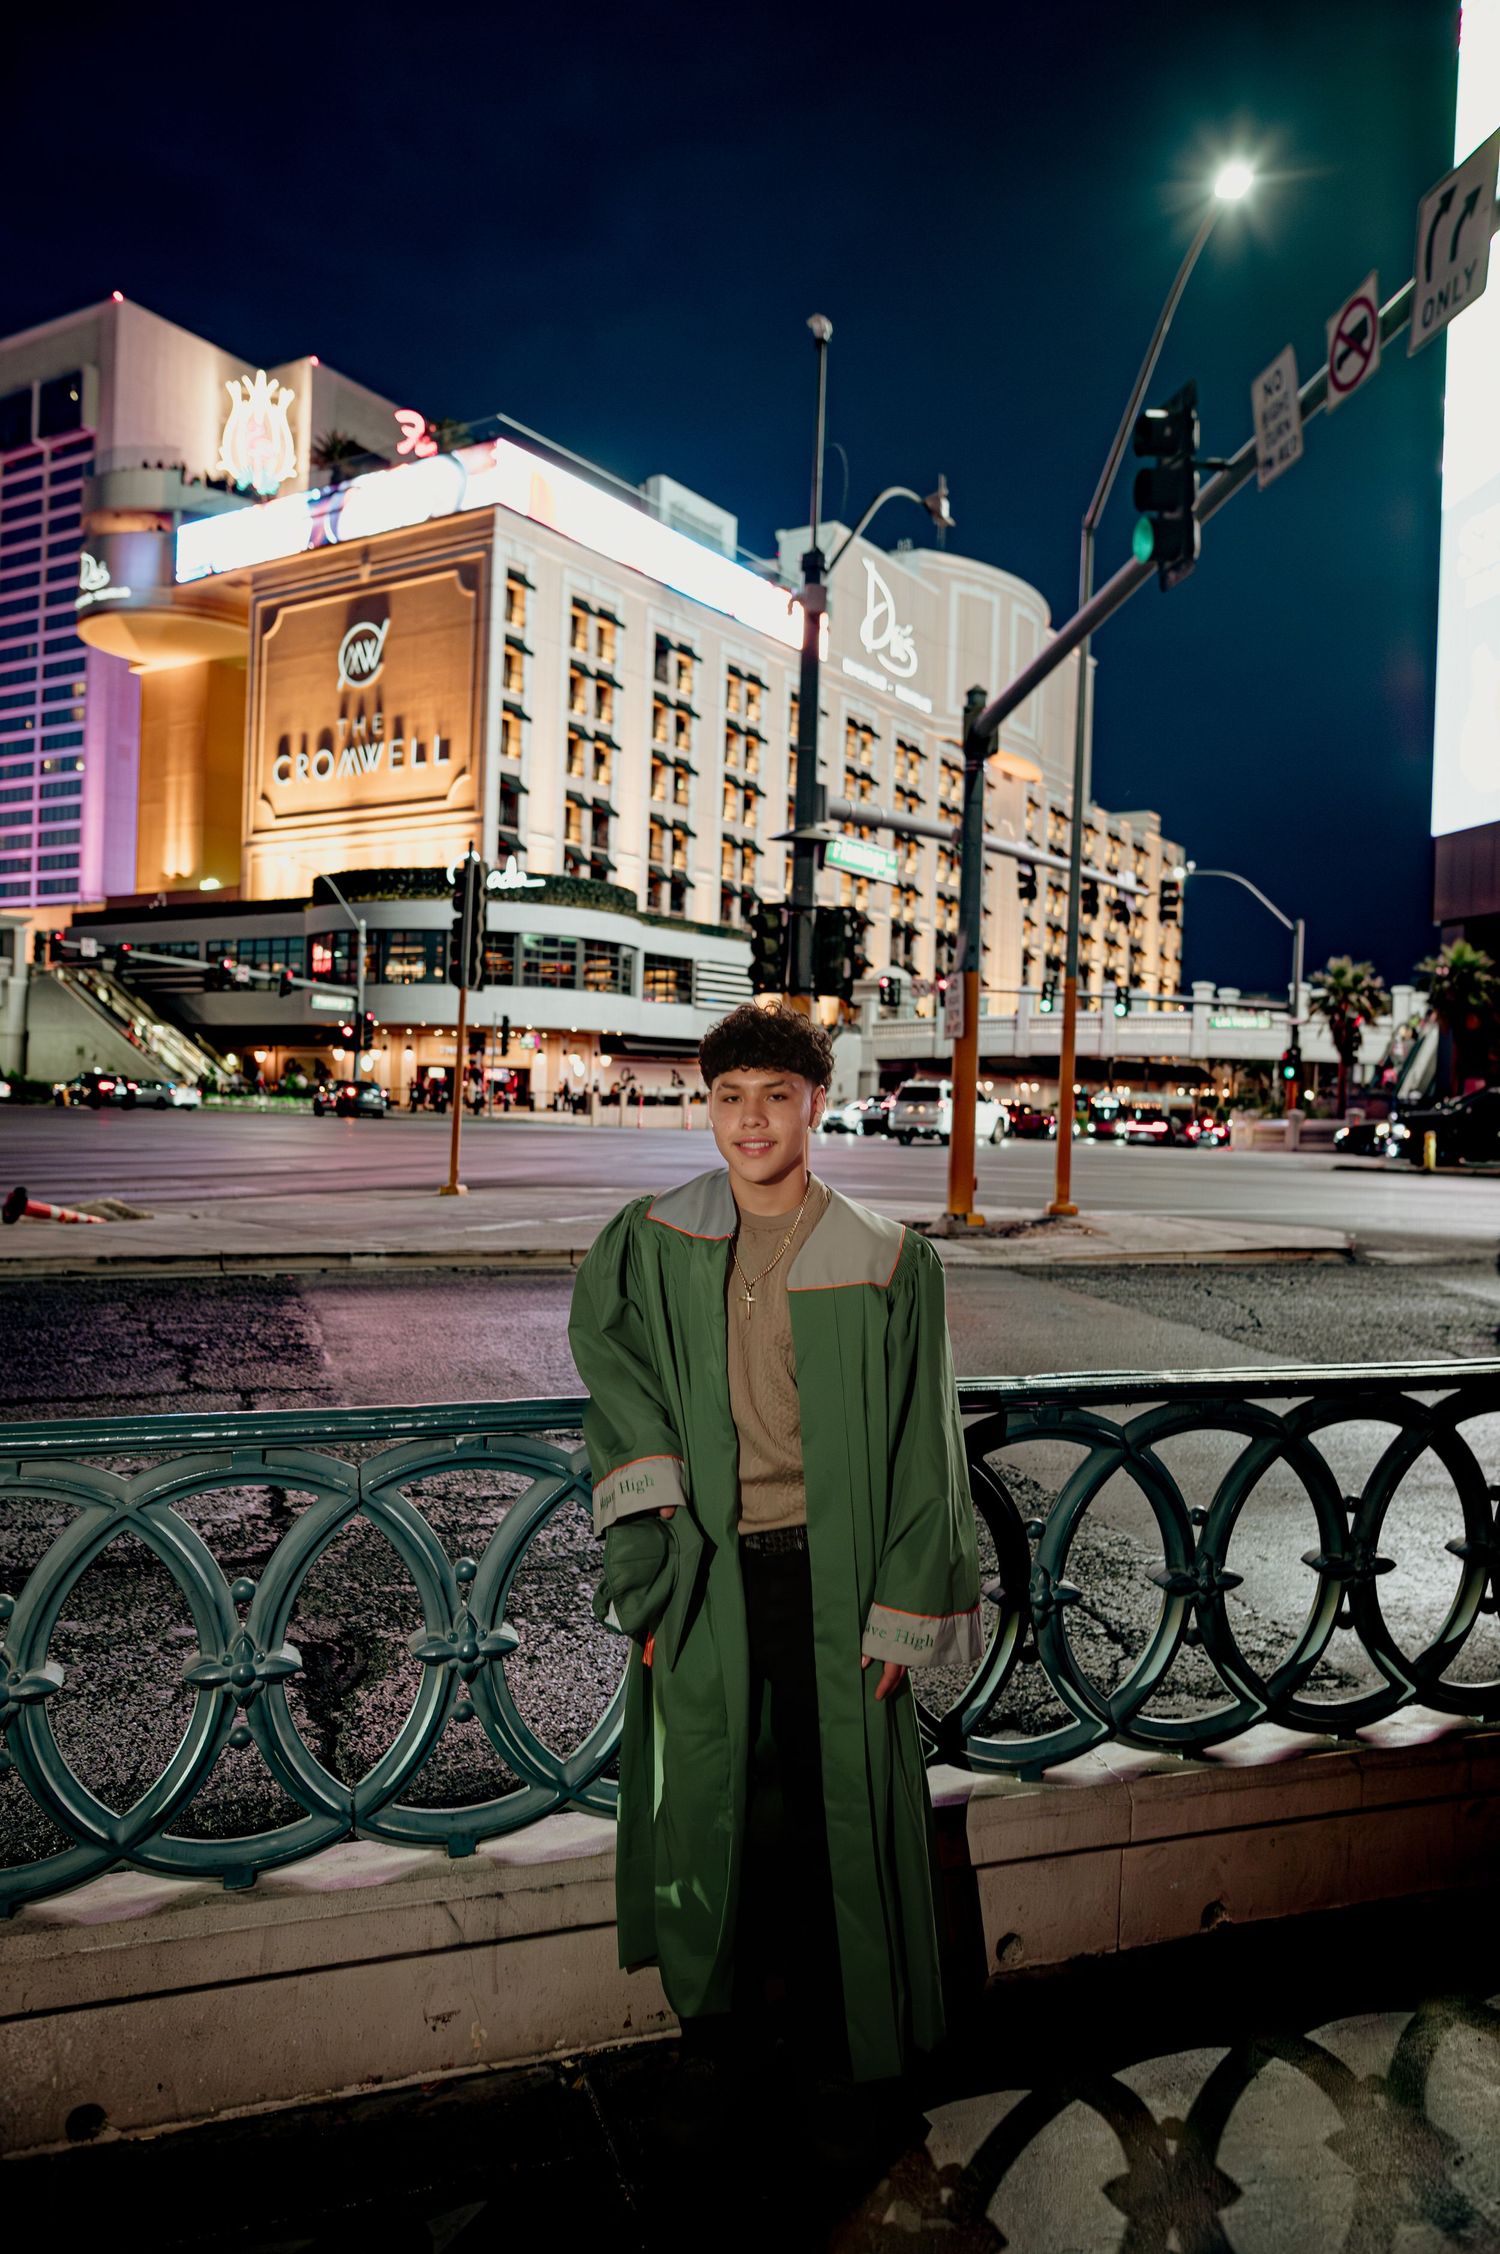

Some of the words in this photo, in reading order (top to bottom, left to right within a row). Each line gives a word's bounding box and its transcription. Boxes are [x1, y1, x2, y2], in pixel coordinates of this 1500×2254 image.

[1422, 257, 1478, 328] ONLY
[1263, 368, 1284, 396] NO
[336, 712, 384, 738] THE
[272, 734, 451, 785] CROMWELL
[619, 1473, 655, 1495] High
[896, 1628, 934, 1651] High
